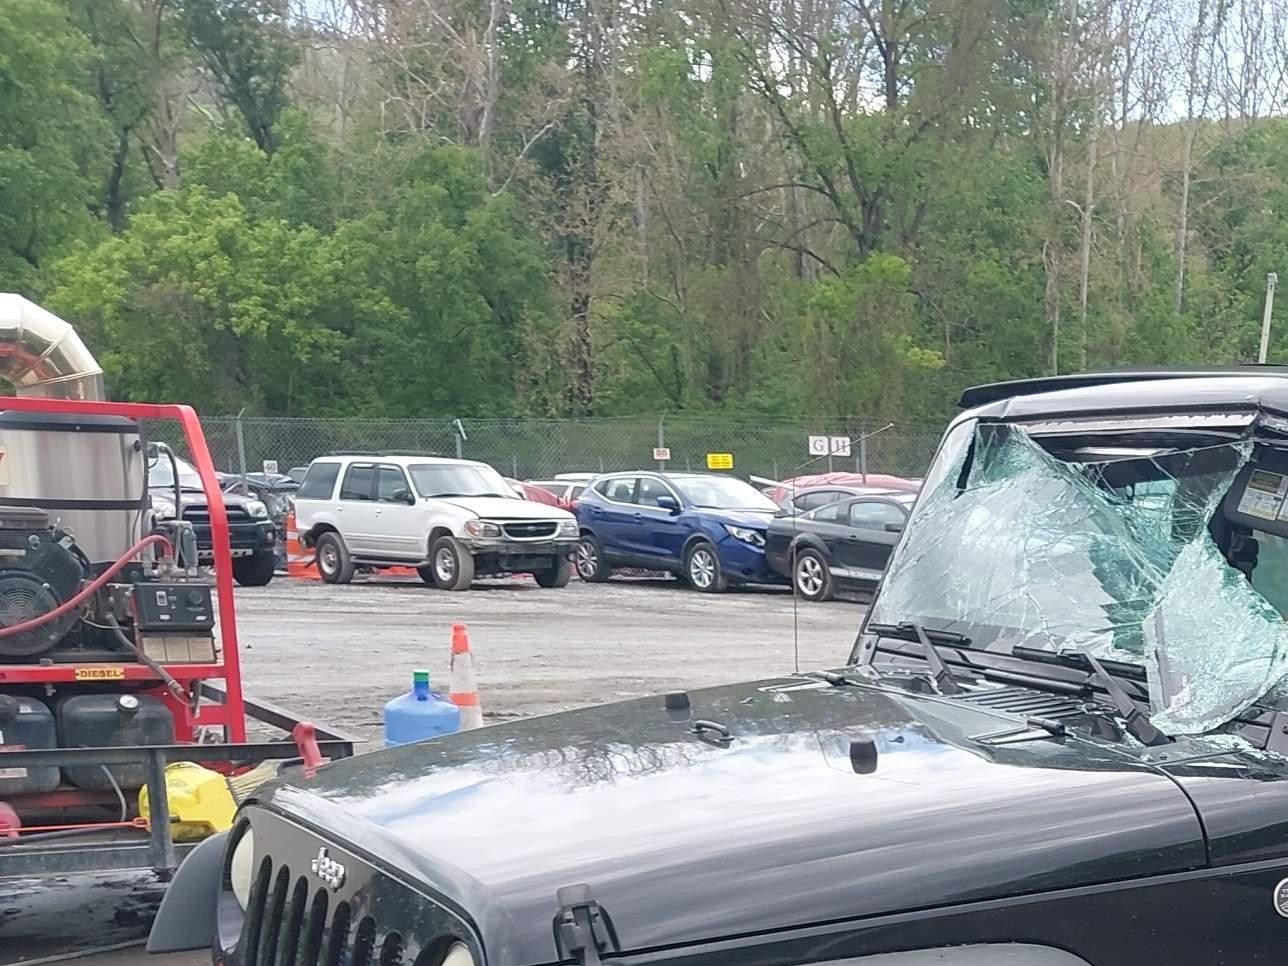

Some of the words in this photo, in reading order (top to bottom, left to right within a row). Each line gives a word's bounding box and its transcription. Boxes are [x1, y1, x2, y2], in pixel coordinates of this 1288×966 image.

[813, 439, 824, 452] G
[80, 669, 121, 678] DIESEL
[311, 846, 345, 889] Jeep
